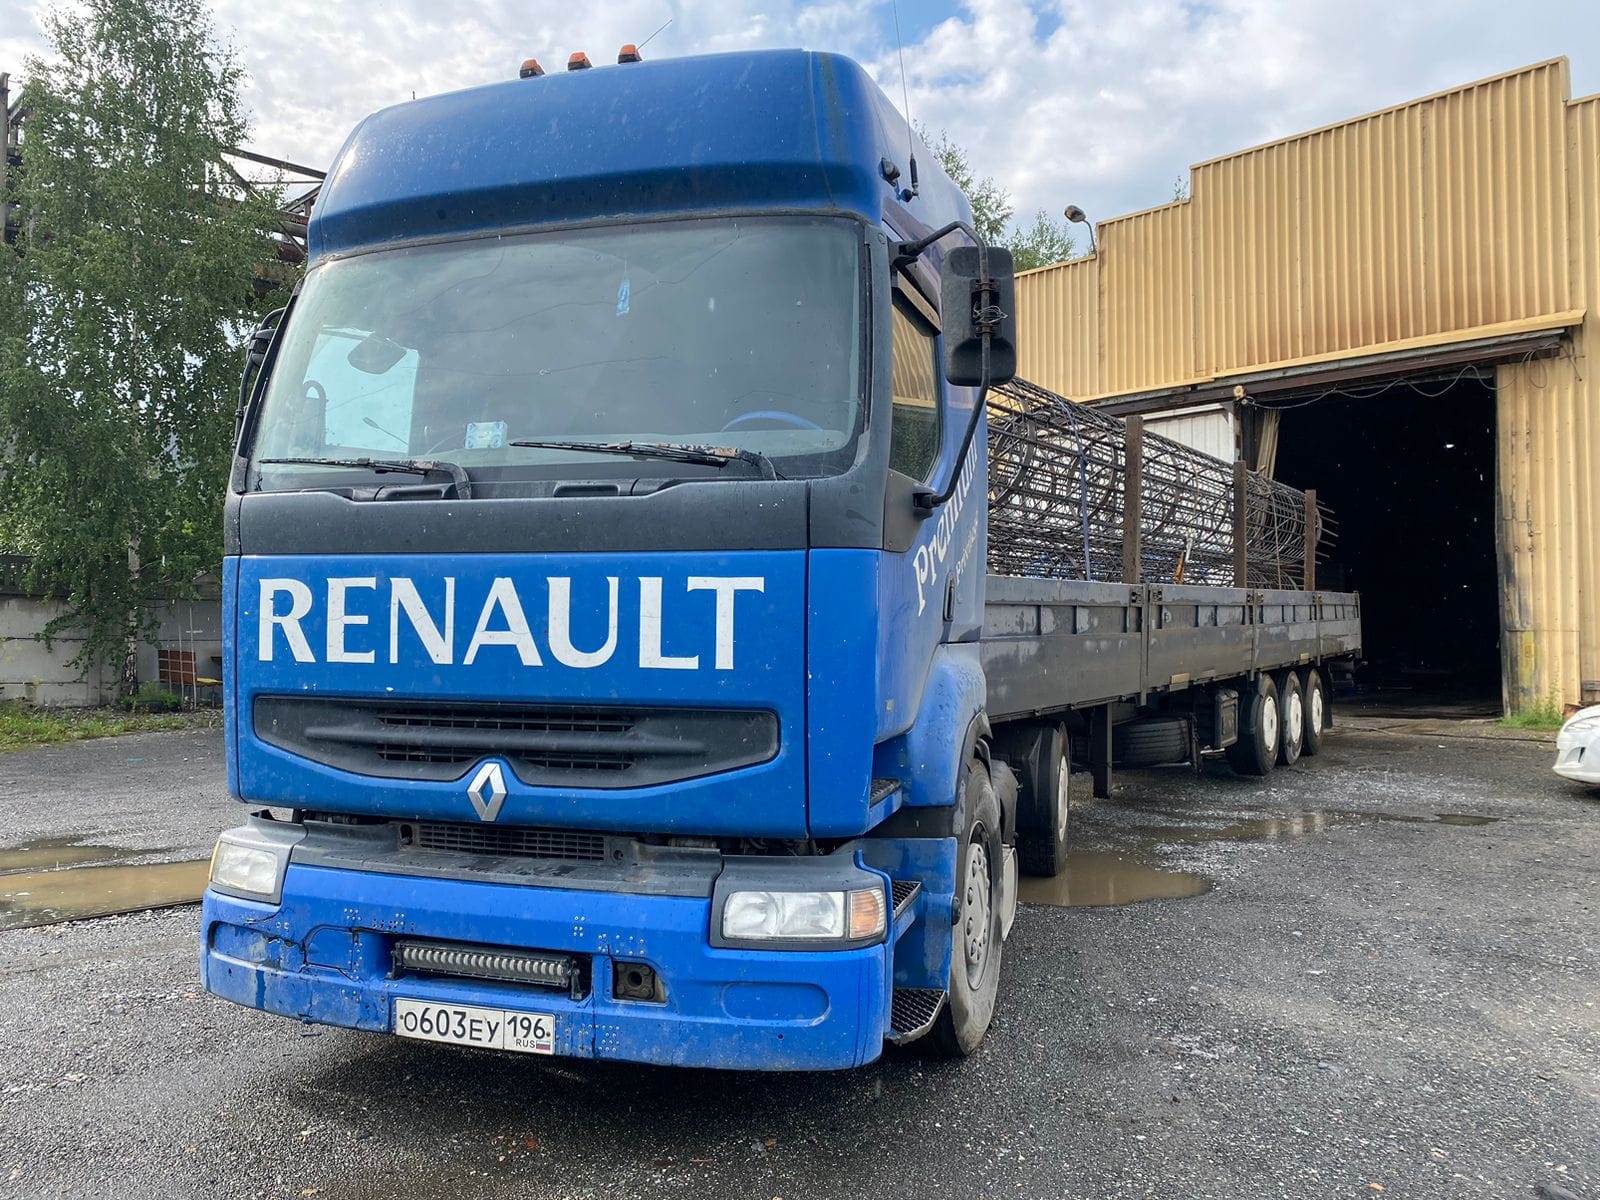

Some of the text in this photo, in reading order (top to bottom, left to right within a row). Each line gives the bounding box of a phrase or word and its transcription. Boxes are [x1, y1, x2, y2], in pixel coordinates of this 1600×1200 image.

[913, 433, 978, 617] Premium
[258, 576, 765, 670] RENAULT
[507, 1016, 545, 1039] 196
[516, 1038, 535, 1049] RUS
